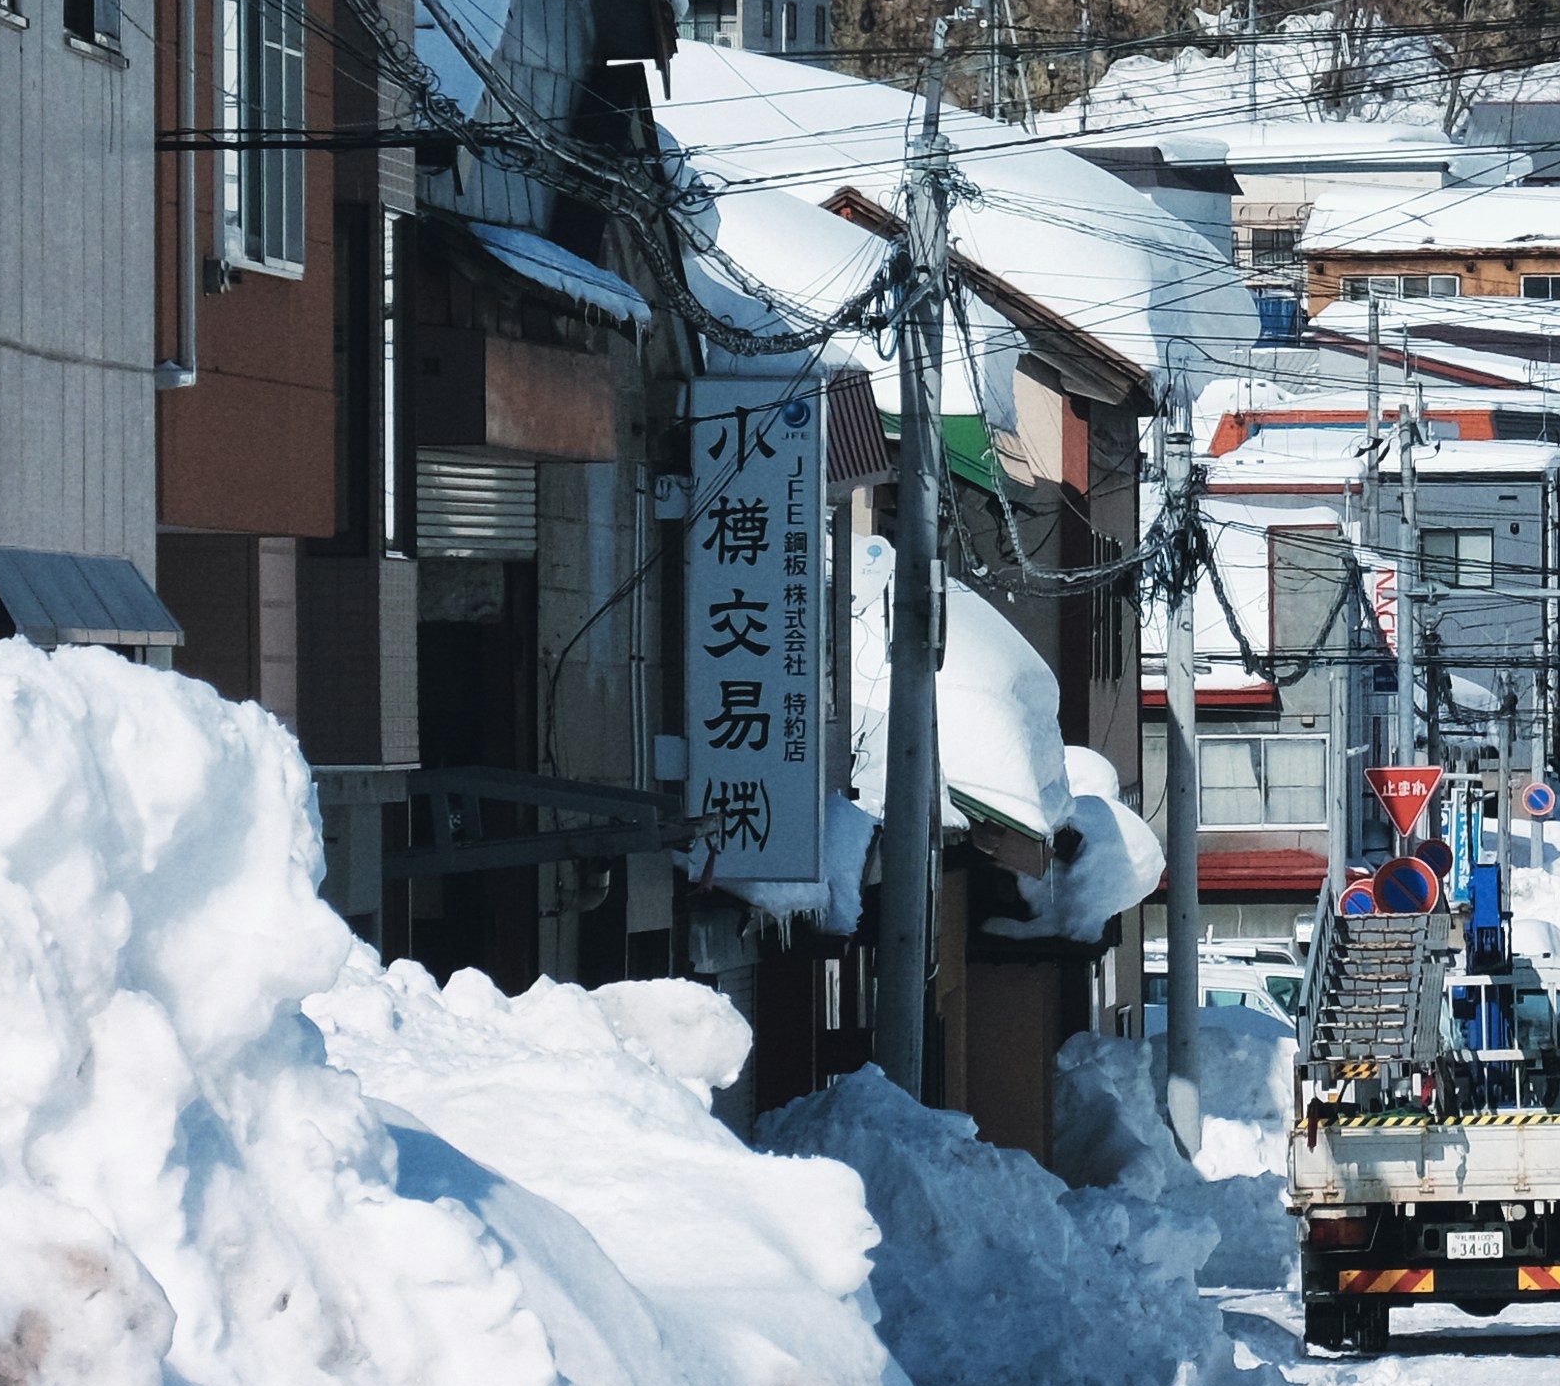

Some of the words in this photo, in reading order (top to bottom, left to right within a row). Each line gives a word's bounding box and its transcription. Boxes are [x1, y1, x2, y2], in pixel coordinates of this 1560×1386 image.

[781, 431, 811, 441] JFE
[1380, 778, 1428, 797] 止まれ
[1460, 1242, 1500, 1257] 34-03
